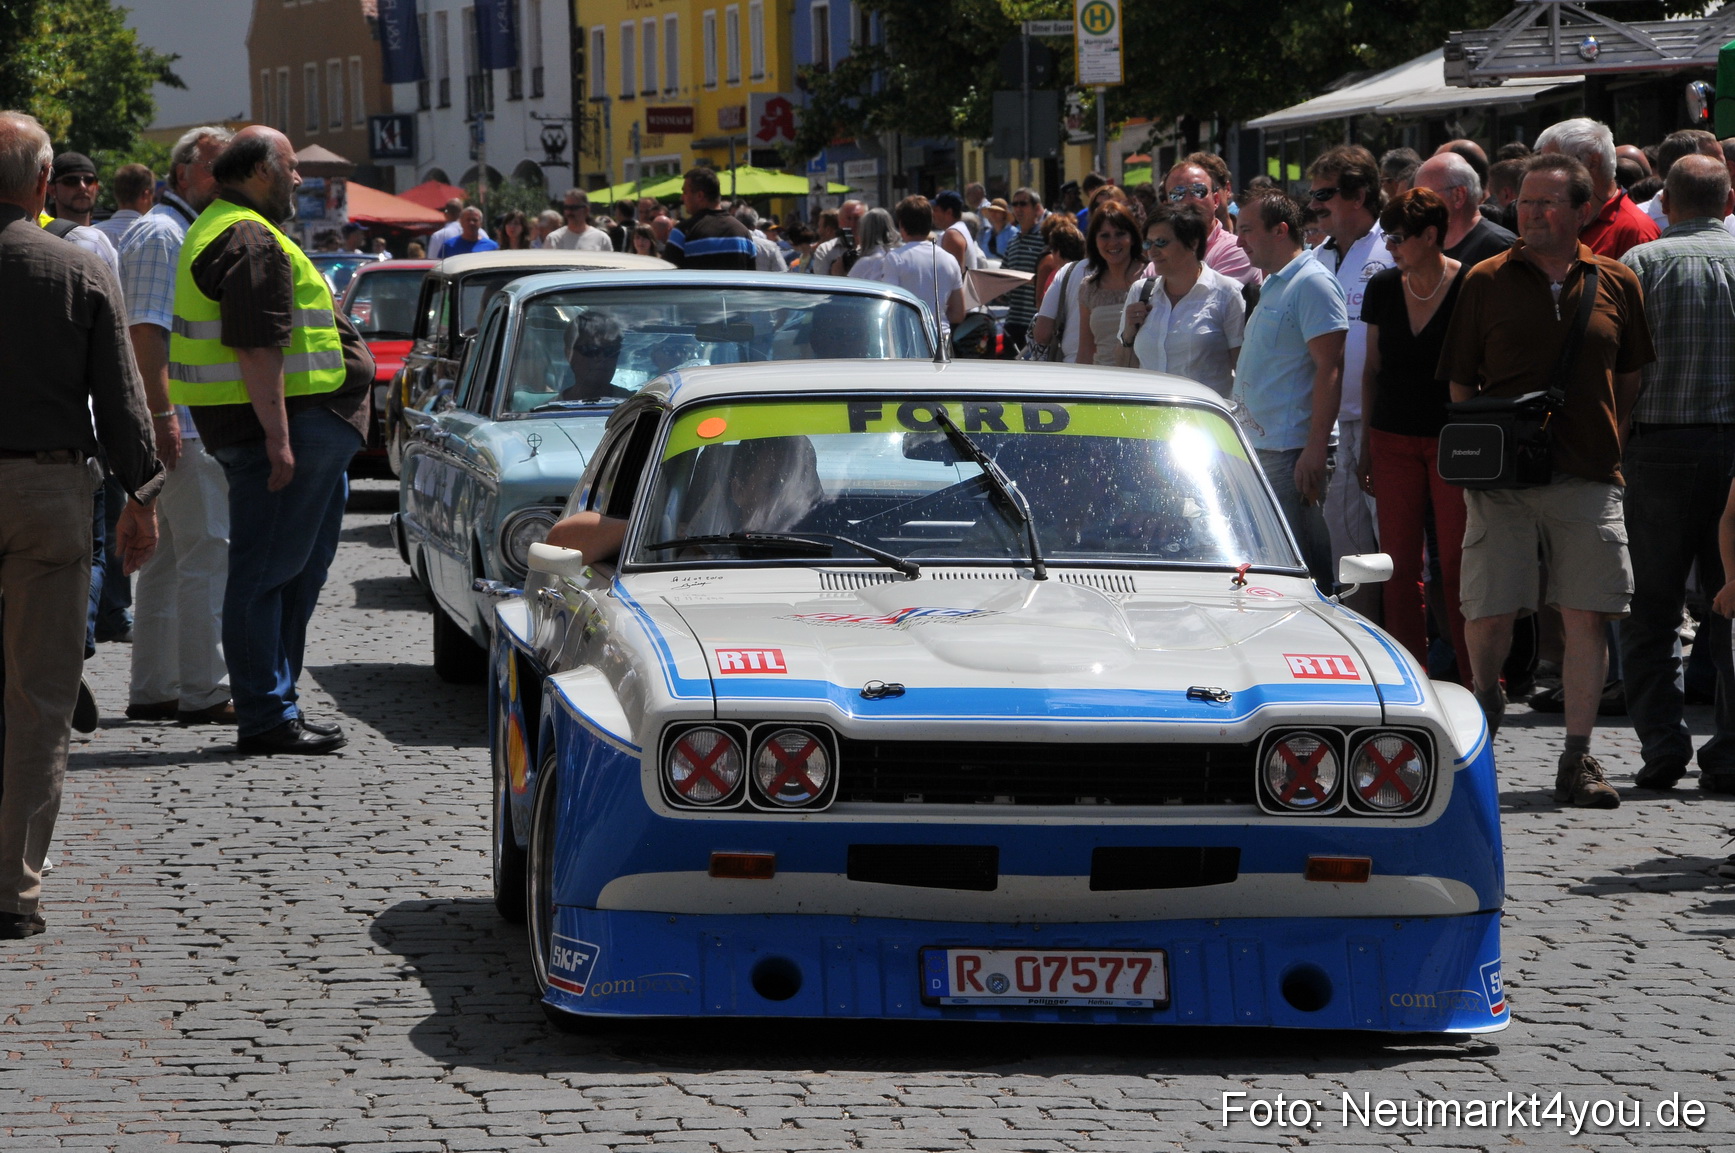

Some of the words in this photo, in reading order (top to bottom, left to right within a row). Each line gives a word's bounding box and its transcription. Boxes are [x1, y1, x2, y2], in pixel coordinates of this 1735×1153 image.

[847, 401, 1070, 432] FORD
[717, 651, 785, 670] RTL
[1286, 656, 1357, 676] RTL
[552, 945, 589, 972] SKF
[932, 978, 942, 988] D
[955, 955, 985, 992] R
[1015, 956, 1152, 994] 07577
